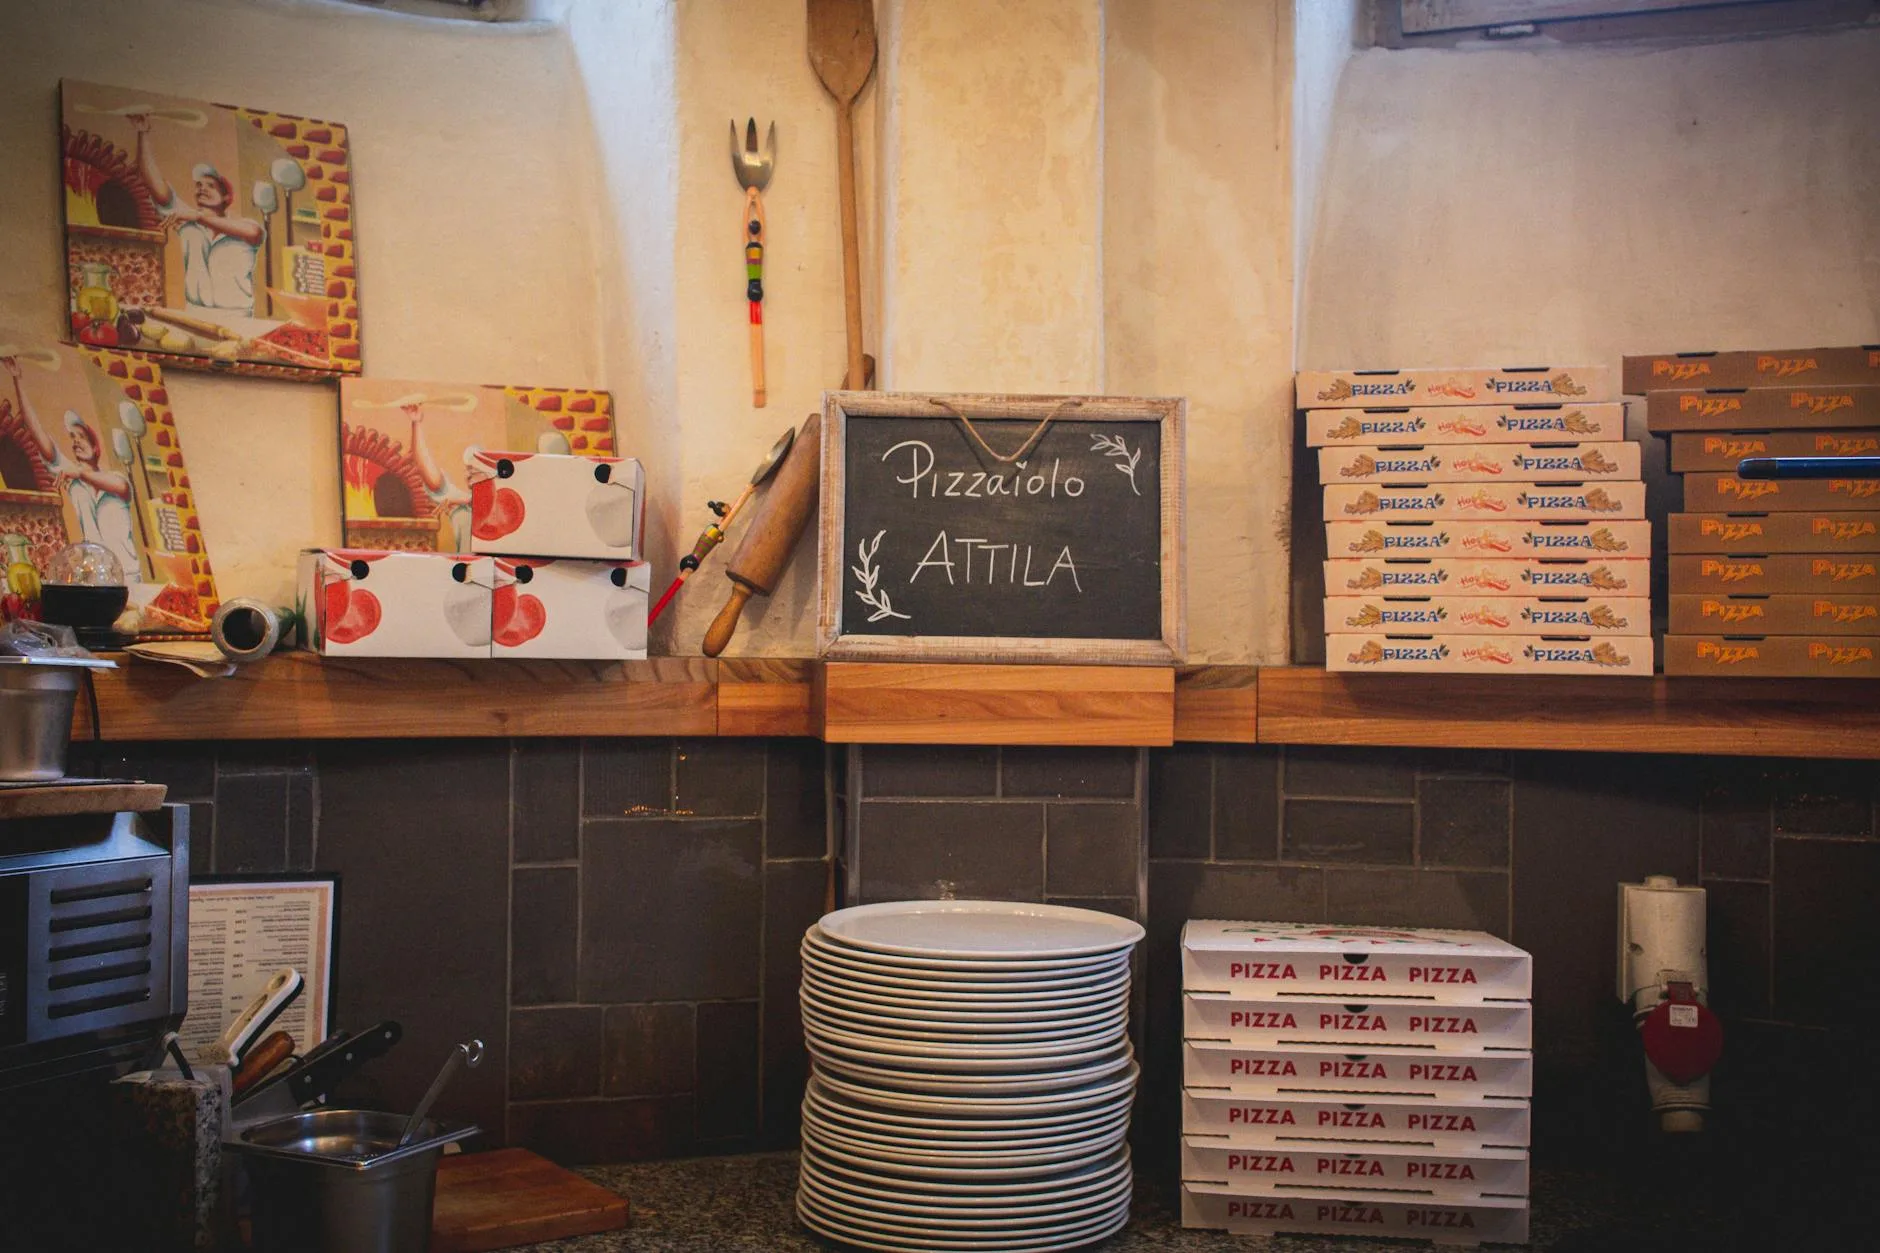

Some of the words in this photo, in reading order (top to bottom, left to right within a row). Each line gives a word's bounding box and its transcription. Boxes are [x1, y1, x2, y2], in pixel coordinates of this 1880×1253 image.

[1351, 382, 1408, 397] PIZZA
[1495, 380, 1552, 394] PIZZA
[1361, 420, 1418, 434] PIZZA
[1507, 417, 1566, 431] PIZZA
[881, 440, 1085, 499] Pizzaiolo
[1375, 458, 1433, 473] PIZZA
[1523, 456, 1583, 470] PIZZA
[1379, 496, 1437, 510] PIZZA
[1527, 495, 1587, 509] PIZZA
[1384, 534, 1442, 548] PIZZA
[1532, 533, 1593, 548] PIZZA
[910, 530, 1083, 593] ATTILA
[1382, 572, 1441, 586] PIZZA
[1531, 571, 1592, 586] PIZZA
[1381, 610, 1440, 624] PIZZA
[1531, 610, 1592, 624] PIZZA
[1382, 647, 1442, 661] PIZZA
[1533, 648, 1595, 662] PIZZA
[1231, 963, 1297, 979] PIZZA
[1319, 965, 1387, 982] PIZZA
[1409, 967, 1478, 984] PIZZA
[1231, 1012, 1298, 1029] PIZZA
[1319, 1014, 1387, 1031] PIZZA
[1409, 1016, 1478, 1034] PIZZA
[1231, 1059, 1298, 1076] PIZZA
[1319, 1061, 1387, 1079] PIZZA
[1409, 1064, 1478, 1082] PIZZA
[1229, 1108, 1296, 1125] PIZZA
[1318, 1110, 1386, 1128] PIZZA
[1408, 1114, 1476, 1132] PIZZA
[1228, 1155, 1295, 1173] PIZZA
[1317, 1158, 1384, 1176] PIZZA
[1407, 1162, 1475, 1180] PIZZA
[1228, 1202, 1295, 1220] PIZZA
[1317, 1206, 1384, 1224] PIZZA
[1406, 1210, 1475, 1229] PIZZA
